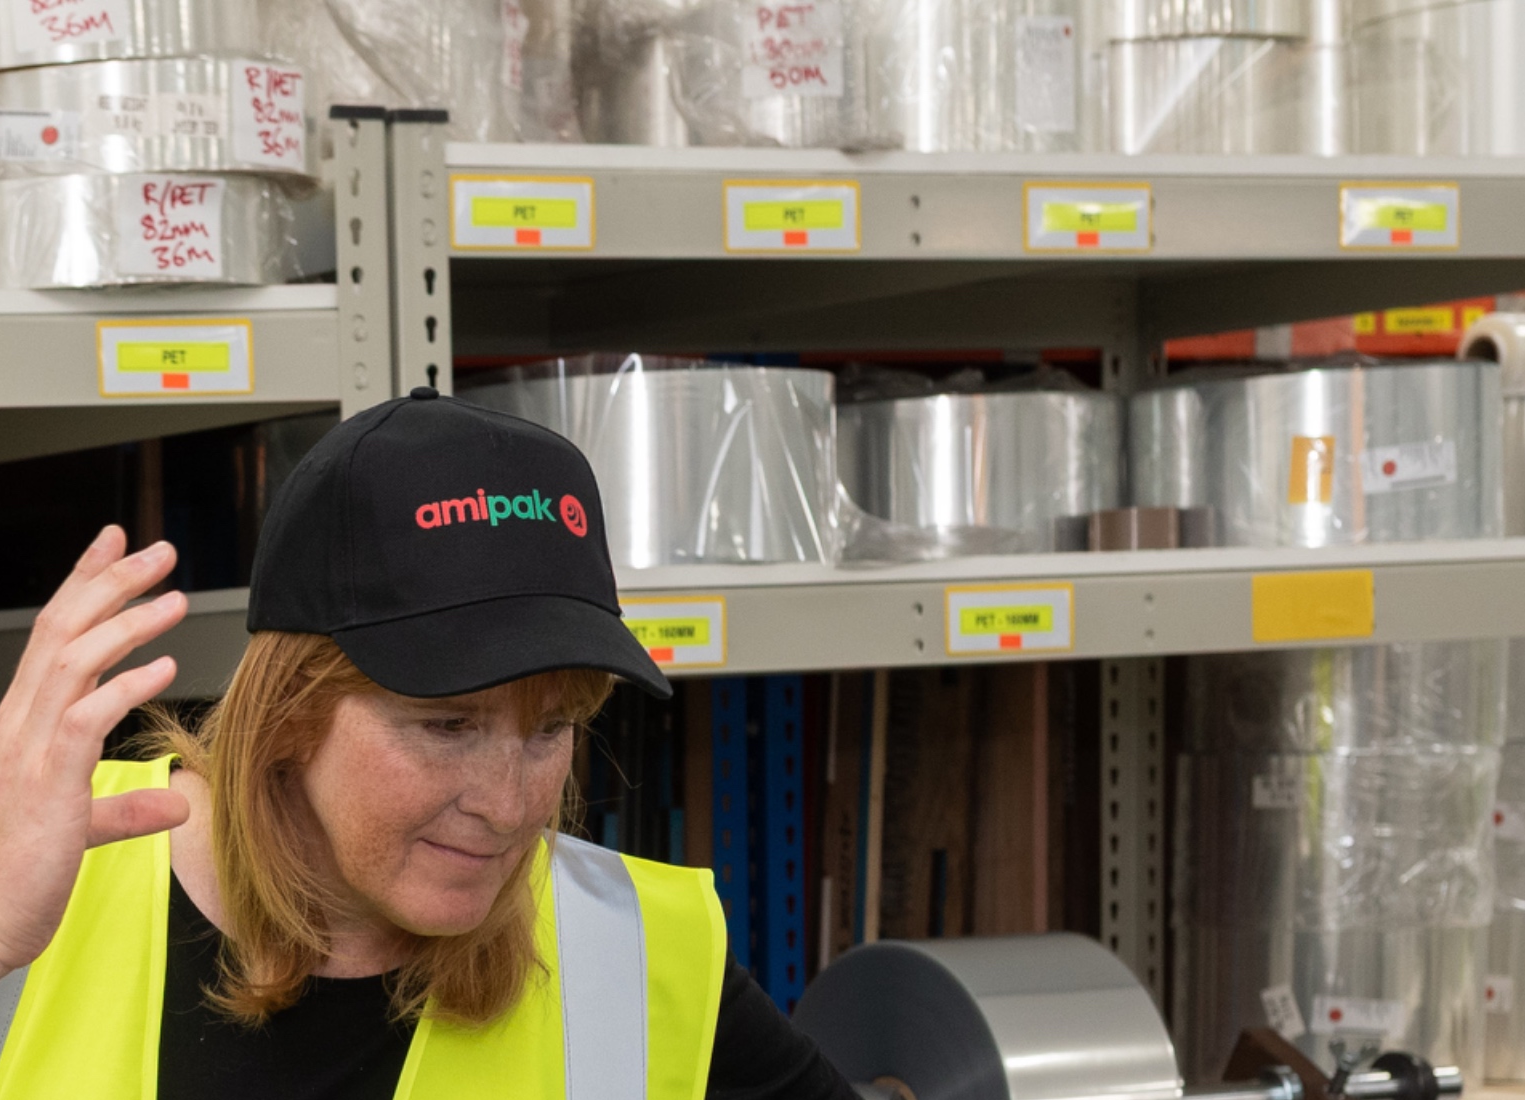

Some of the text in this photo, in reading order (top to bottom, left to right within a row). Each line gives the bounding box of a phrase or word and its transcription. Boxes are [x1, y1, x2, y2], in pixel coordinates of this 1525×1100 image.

[757, 4, 814, 31] PET
[142, 180, 217, 216] R/PET
[513, 205, 536, 220] PET
[783, 207, 805, 223] PET
[162, 349, 187, 365] PET
[415, 488, 556, 530] amipak
[975, 613, 995, 629] PET
